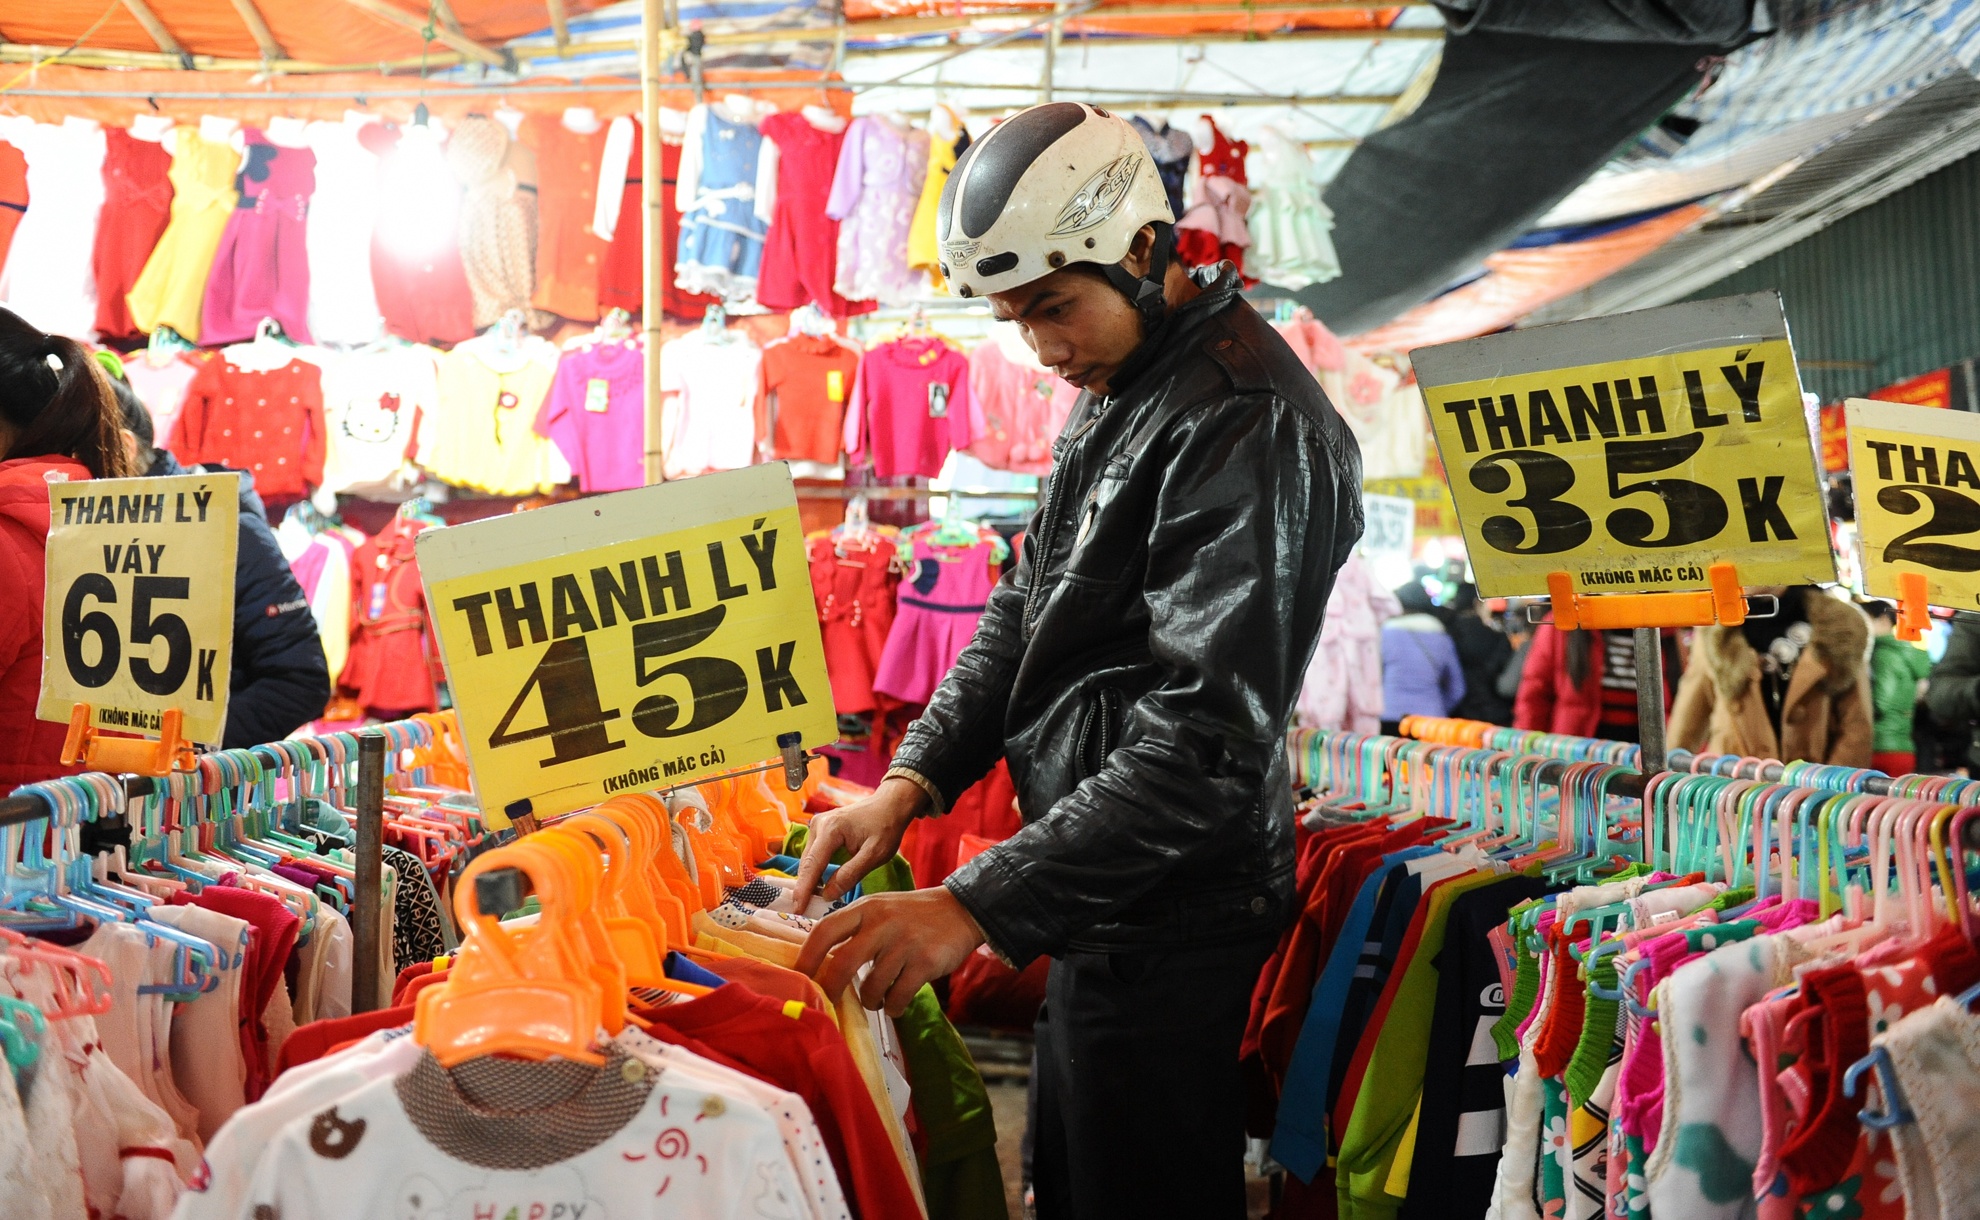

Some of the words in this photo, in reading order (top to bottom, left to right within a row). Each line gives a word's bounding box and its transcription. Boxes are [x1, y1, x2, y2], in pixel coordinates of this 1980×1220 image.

[951, 251, 966, 259] VIA
[1443, 375, 1667, 453] THANH
[1683, 348, 1765, 430] LÝ
[61, 493, 164, 525] THANH
[175, 485, 213, 523] LÝ
[103, 538, 166, 575] VÁY
[1580, 569, 1635, 586] (KHÔNG
[1638, 566, 1673, 584] MẶC
[1677, 561, 1704, 582] CẢ)
[452, 550, 692, 657] THANH
[706, 517, 778, 602] LÝ
[602, 768, 660, 794] (KHÔNG
[662, 756, 697, 778] MẶC
[700, 745, 726, 767] CẢ)
